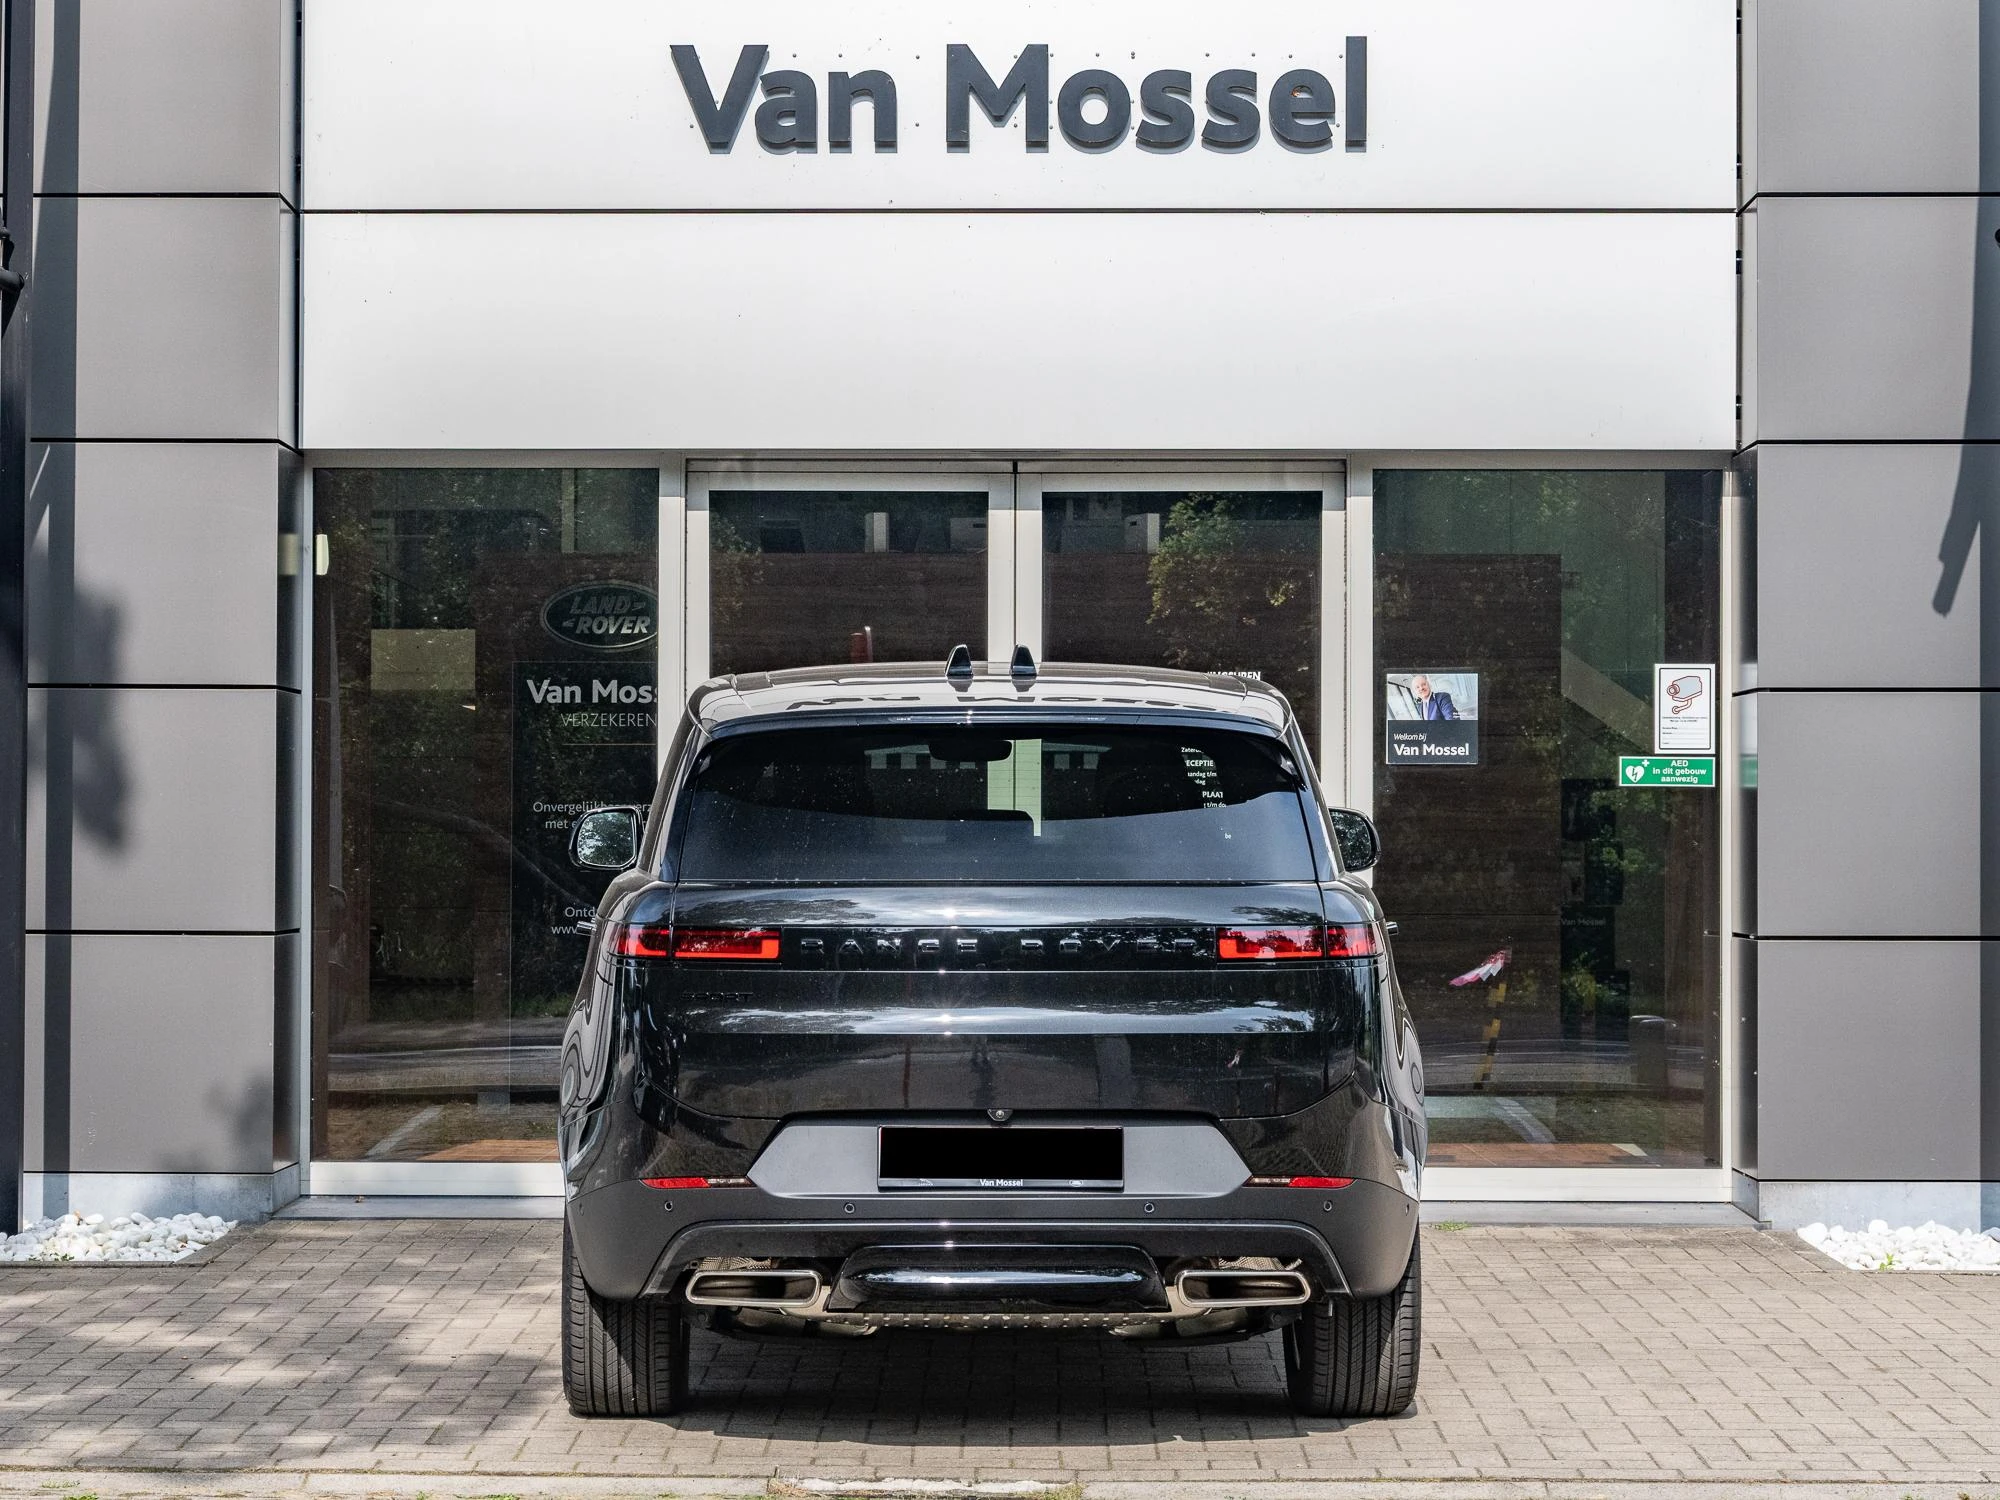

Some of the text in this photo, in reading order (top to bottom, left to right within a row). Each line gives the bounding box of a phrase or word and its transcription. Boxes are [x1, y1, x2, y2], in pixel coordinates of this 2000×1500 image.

[670, 36, 1367, 153] Van Mossel
[569, 596, 631, 614] LAND
[575, 616, 650, 634] ROVER
[527, 680, 582, 703] Van
[1419, 733, 1427, 742] bij
[1393, 743, 1469, 755] Van Mossel
[1675, 768, 1706, 776] gebouw
[1661, 776, 1698, 784] aanwezig
[545, 820, 568, 829] met
[801, 938, 1198, 954] RANGE ROVER
